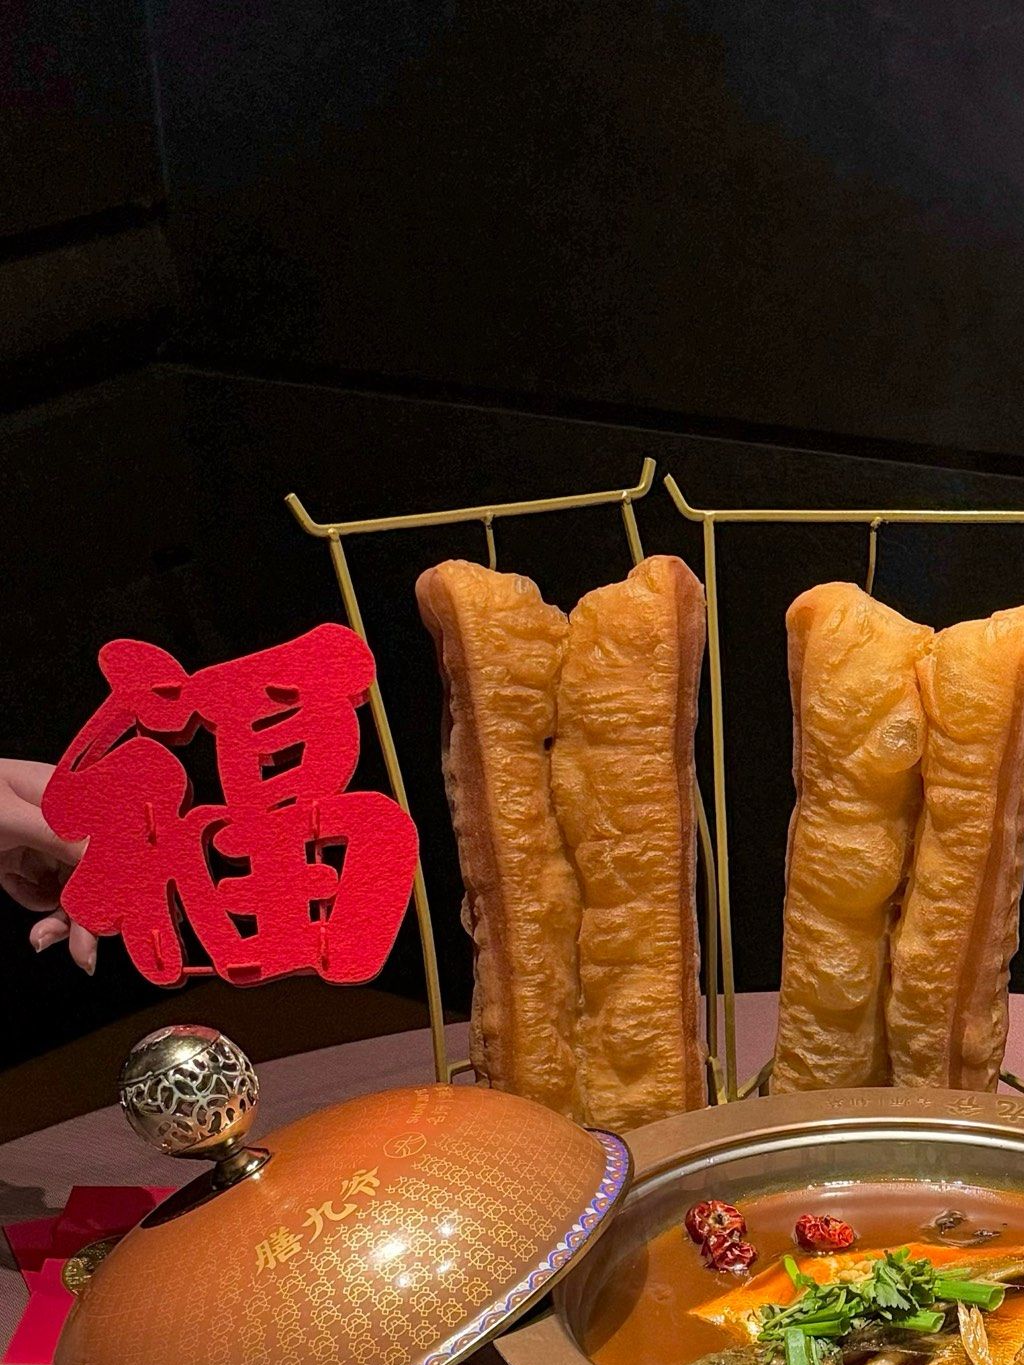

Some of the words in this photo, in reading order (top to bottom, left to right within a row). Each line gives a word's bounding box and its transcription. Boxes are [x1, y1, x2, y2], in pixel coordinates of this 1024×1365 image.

[41, 621, 420, 989] 福
[254, 1165, 381, 1277] 膳九爷
